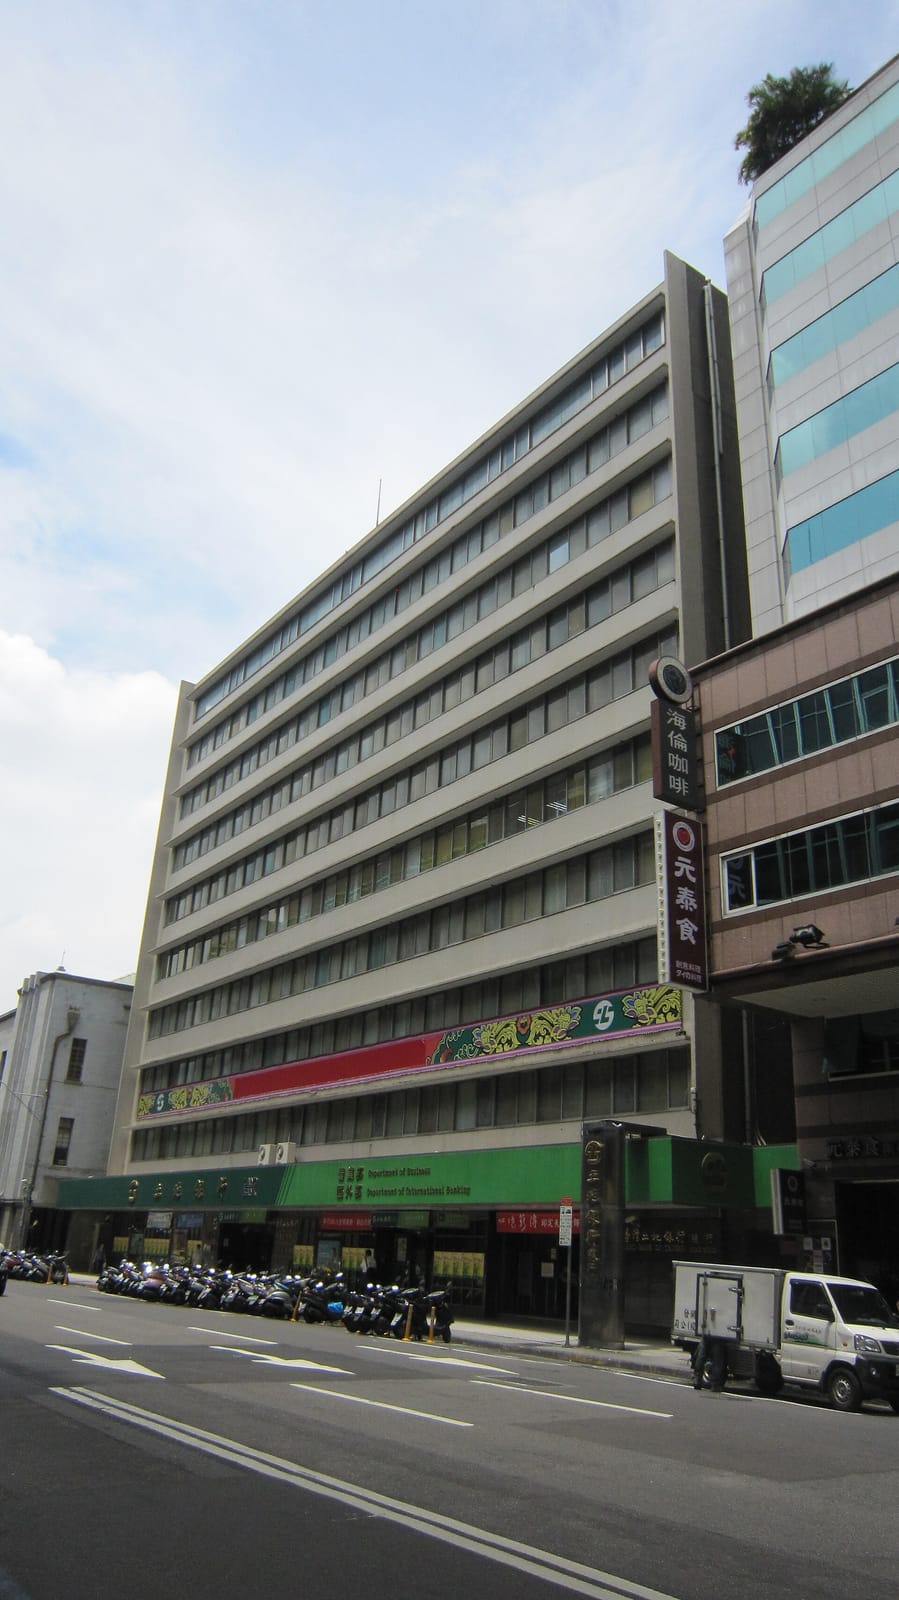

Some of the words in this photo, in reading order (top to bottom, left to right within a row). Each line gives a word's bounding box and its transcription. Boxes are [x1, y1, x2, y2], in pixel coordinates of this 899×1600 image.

[666, 707, 689, 797] 海倫咖啡
[674, 856, 698, 946] 元泰食
[398, 1186, 405, 1196] of
[406, 1186, 444, 1196] International
[399, 1168, 406, 1177] of
